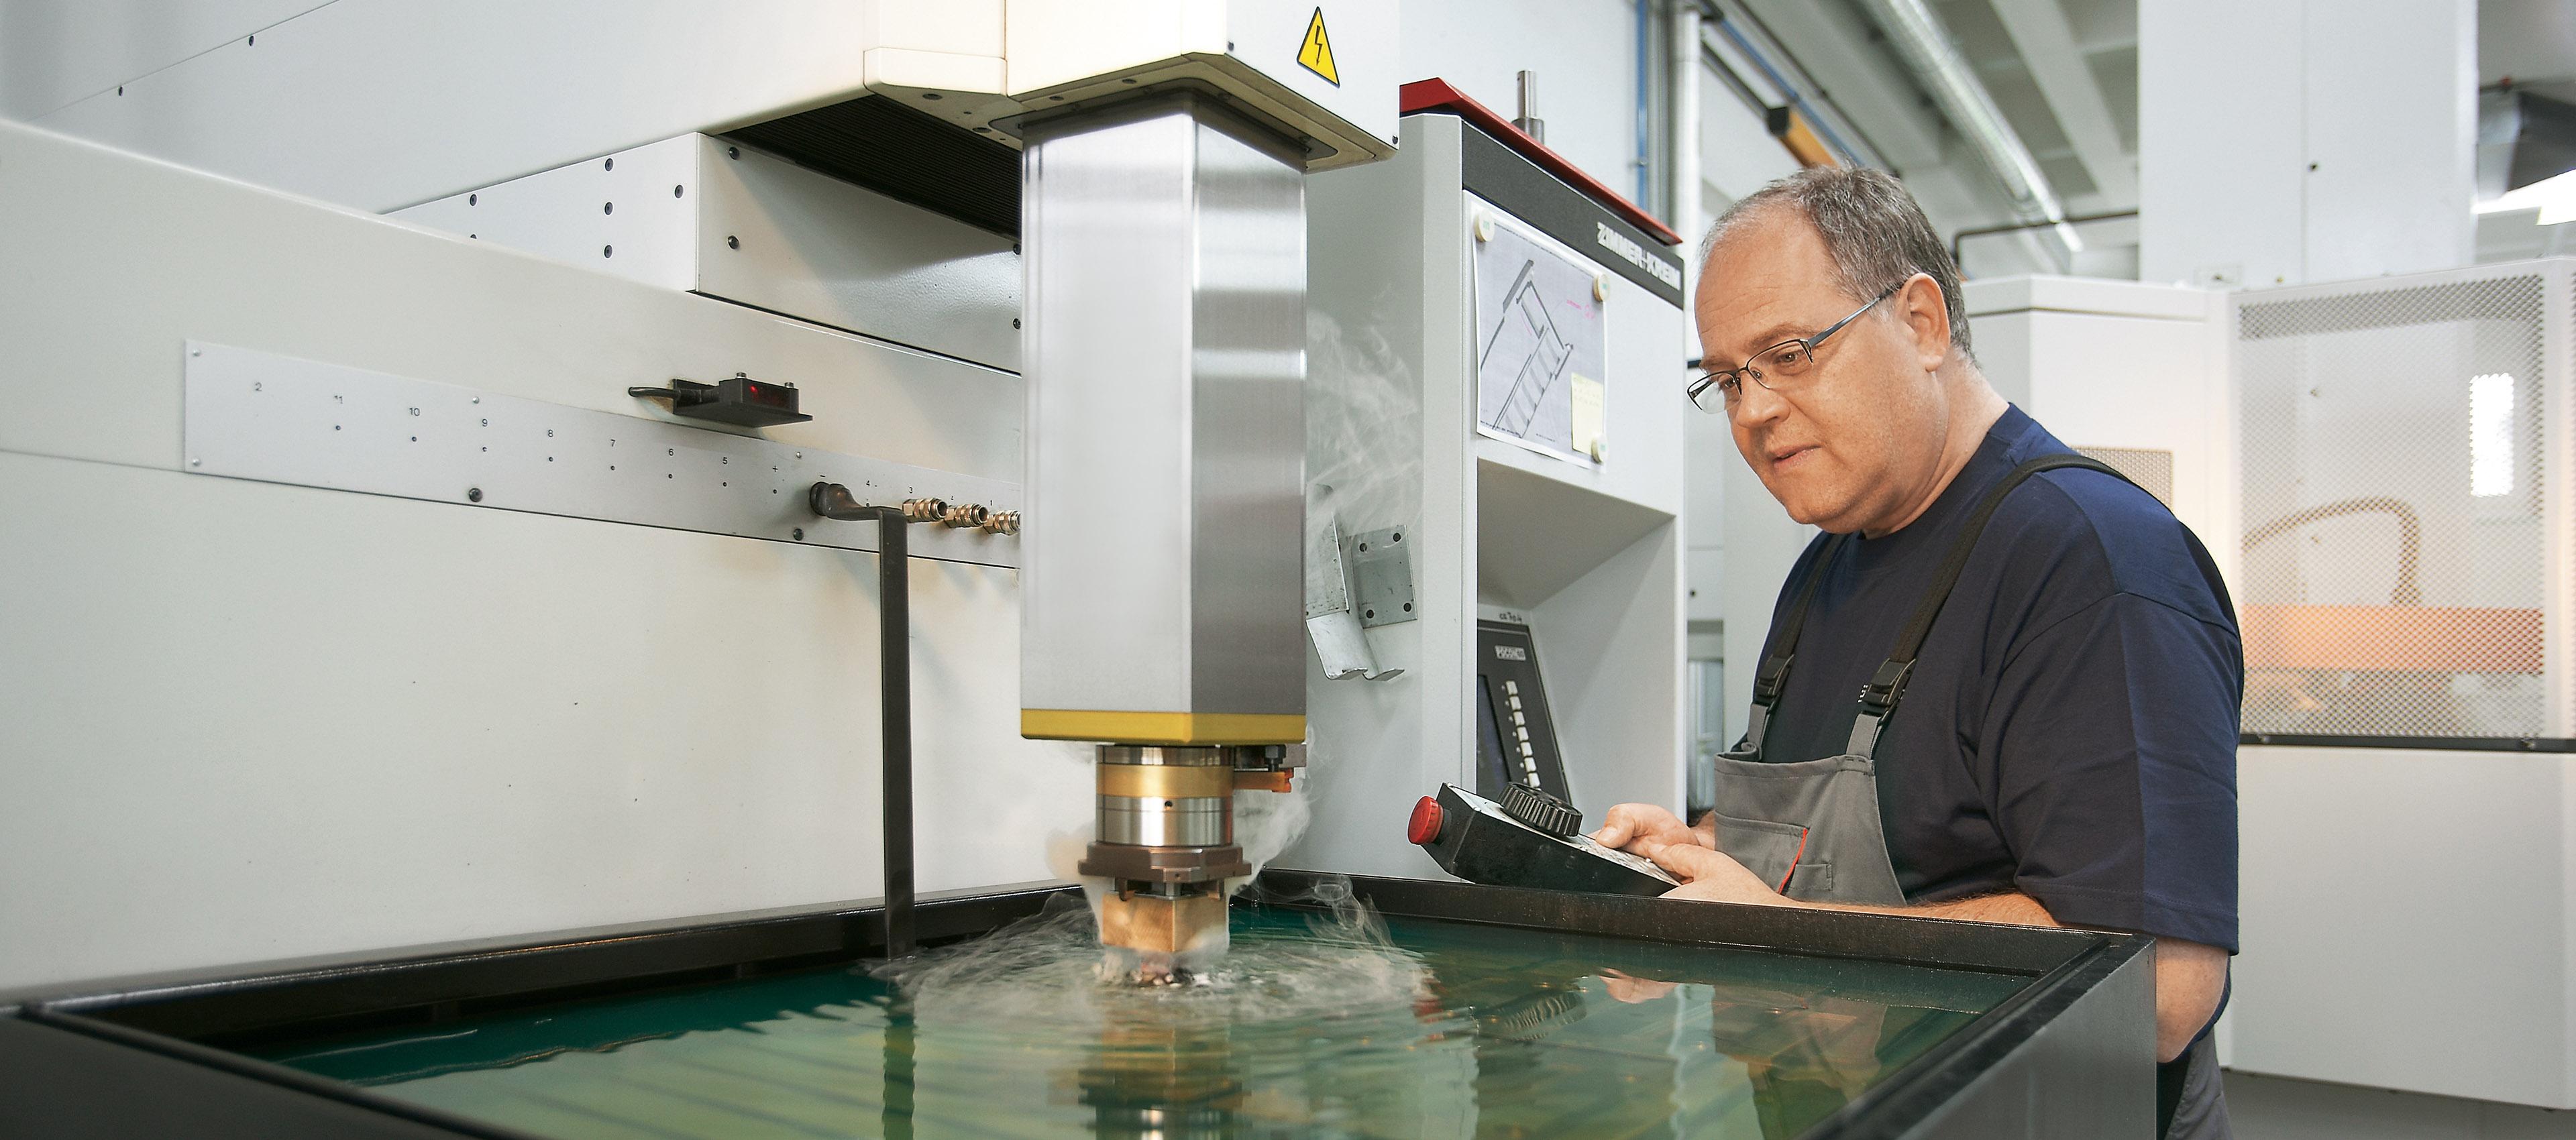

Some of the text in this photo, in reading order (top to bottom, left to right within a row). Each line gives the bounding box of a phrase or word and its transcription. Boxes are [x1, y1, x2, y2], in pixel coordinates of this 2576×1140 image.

[409, 407, 420, 416] 10
[482, 418, 488, 427] 9
[547, 429, 553, 438] 8
[610, 439, 616, 447] 7
[668, 448, 674, 457] 6
[722, 457, 728, 465] 5
[908, 486, 913, 494] 3
